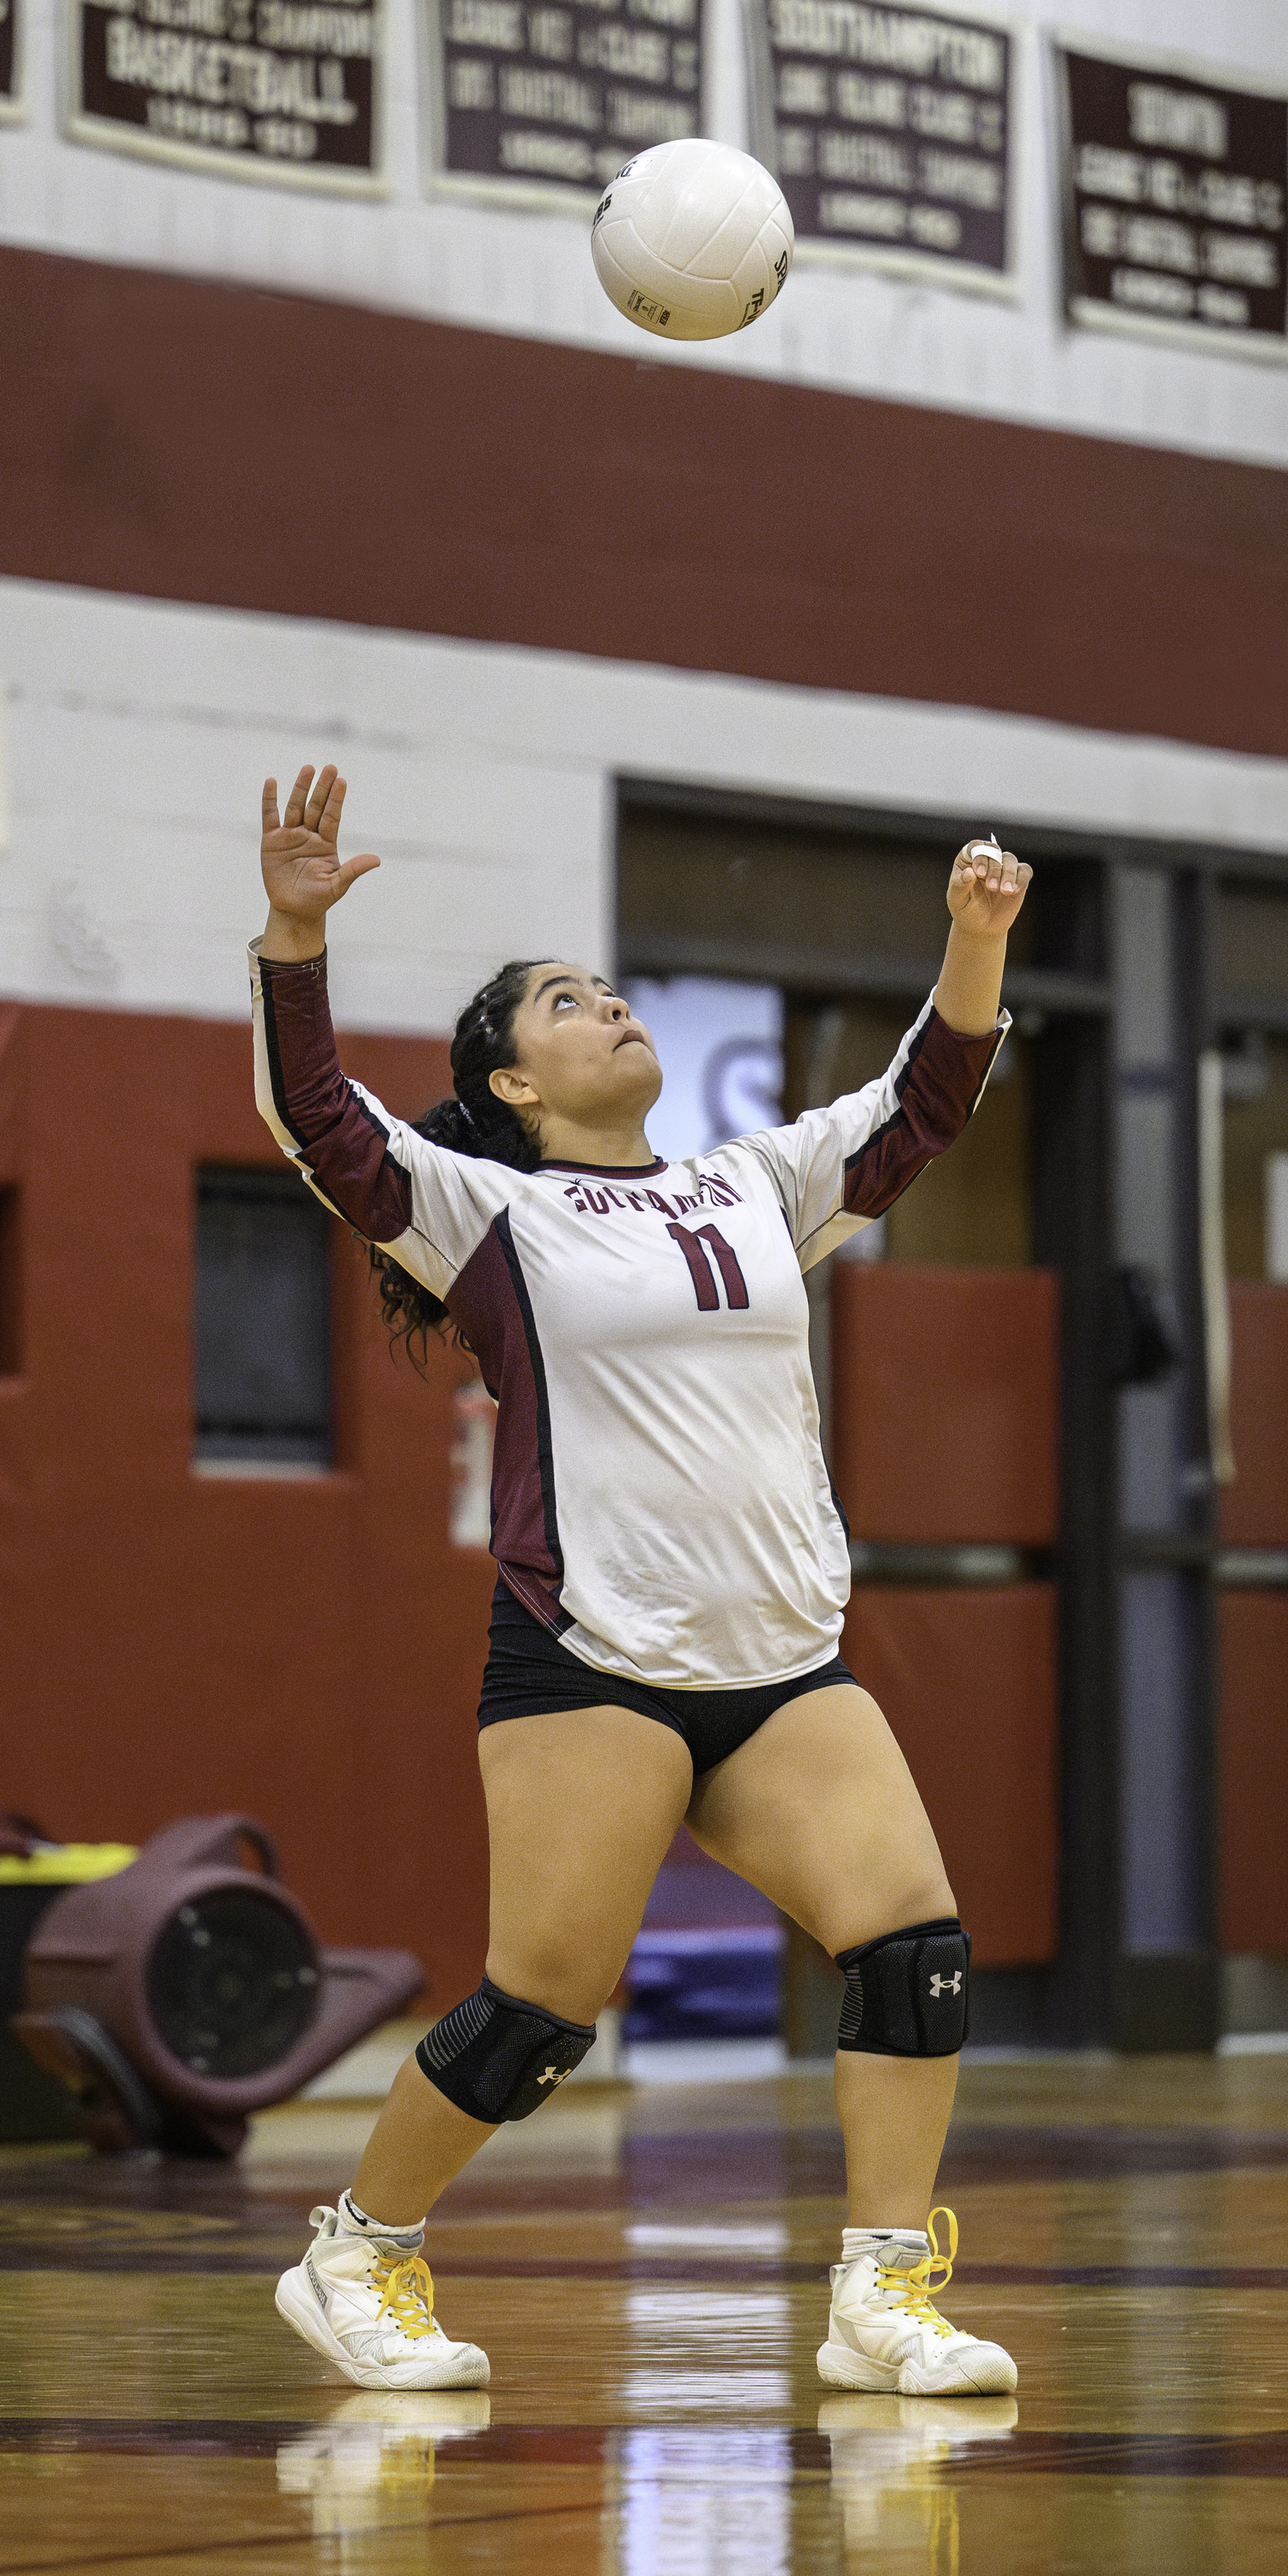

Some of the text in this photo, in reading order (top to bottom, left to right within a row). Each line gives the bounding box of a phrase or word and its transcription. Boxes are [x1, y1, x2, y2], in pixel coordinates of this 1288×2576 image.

[106, 17, 357, 125] BASKETBALL
[773, 0, 1003, 91] SOUTHAMPTON
[665, 1222, 750, 1312] 11
